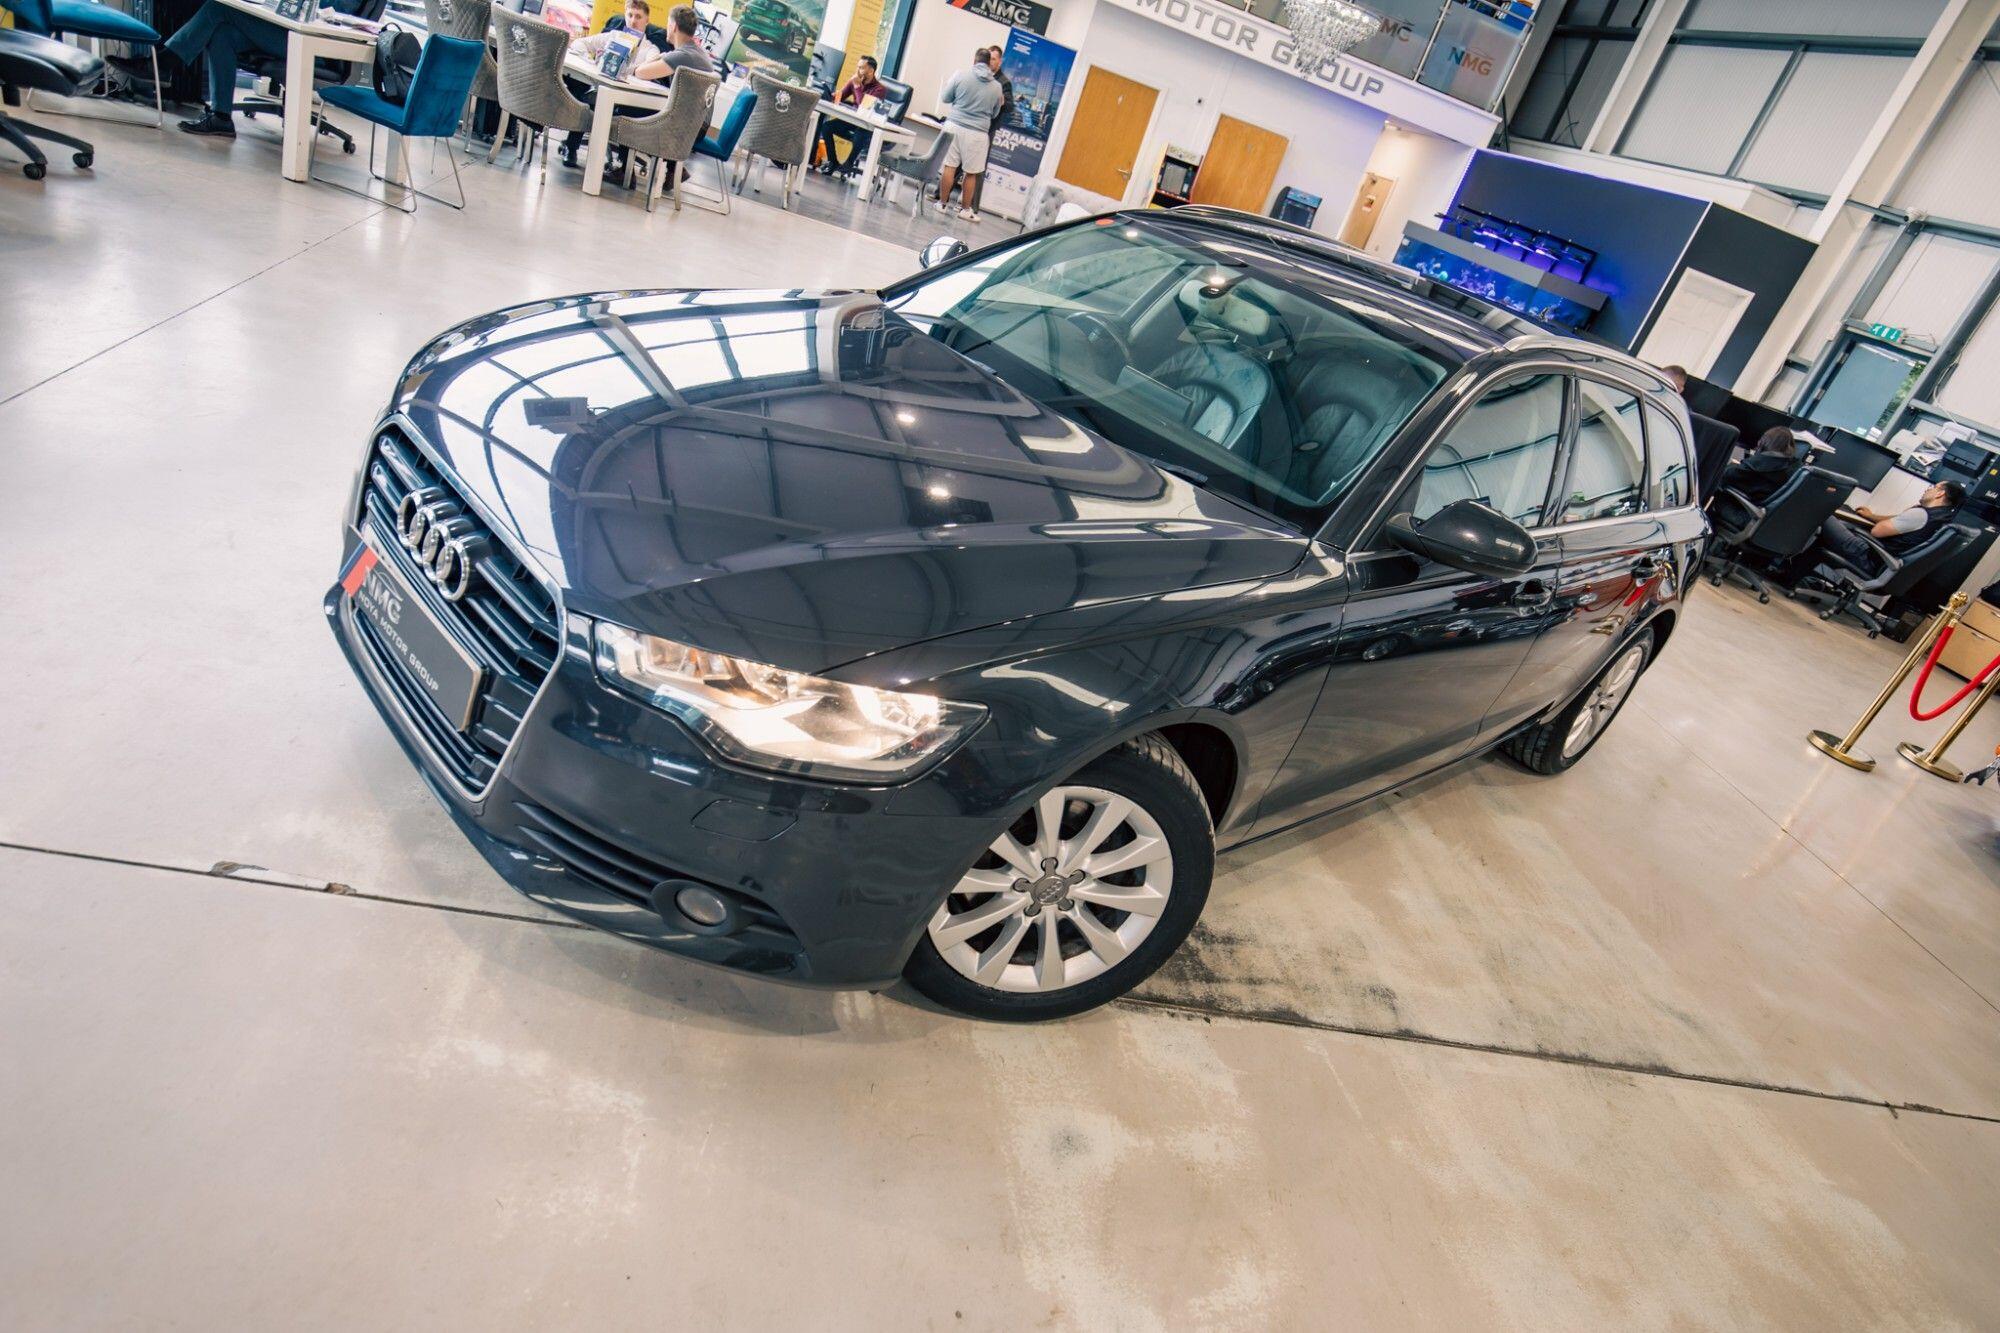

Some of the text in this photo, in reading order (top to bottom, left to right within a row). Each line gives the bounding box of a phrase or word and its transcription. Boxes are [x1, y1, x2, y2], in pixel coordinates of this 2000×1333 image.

[980, 0, 1030, 24] NMG
[1271, 39, 1384, 96] GOUP
[1448, 47, 1493, 76] NMG
[363, 566, 402, 624] NMG
[359, 591, 439, 691] NOVA MOTOR GROUP
